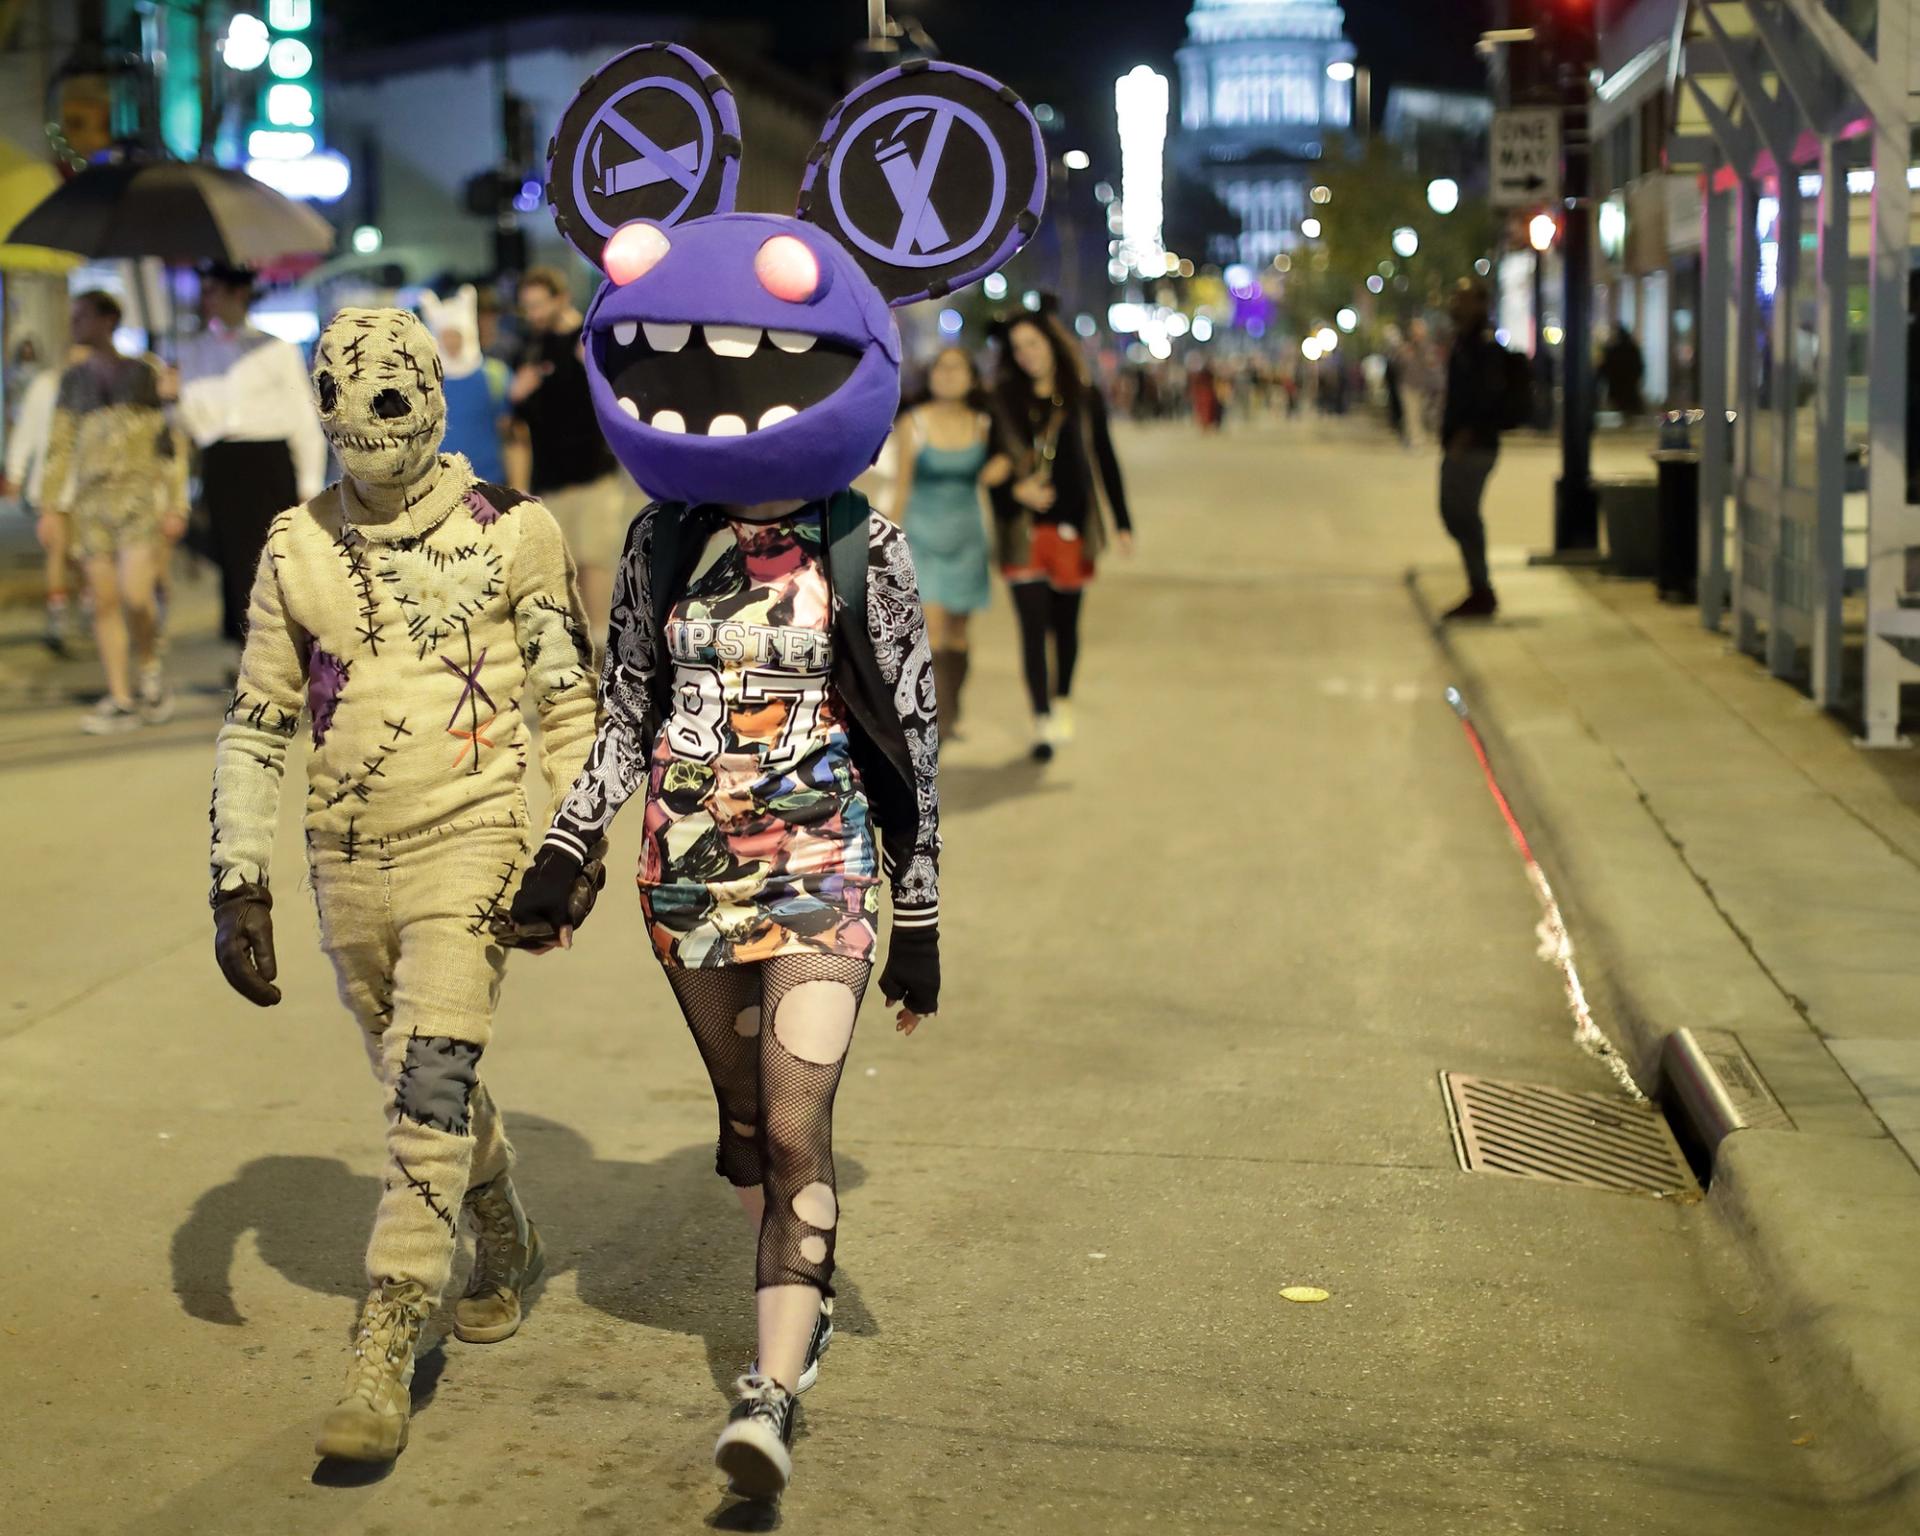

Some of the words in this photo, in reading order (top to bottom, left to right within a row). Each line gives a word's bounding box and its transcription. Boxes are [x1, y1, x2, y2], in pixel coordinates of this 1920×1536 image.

[1500, 115, 1547, 141] ONE
[1499, 145, 1551, 168] WAY
[665, 621, 831, 668] IPSTER
[667, 660, 830, 768] 87
